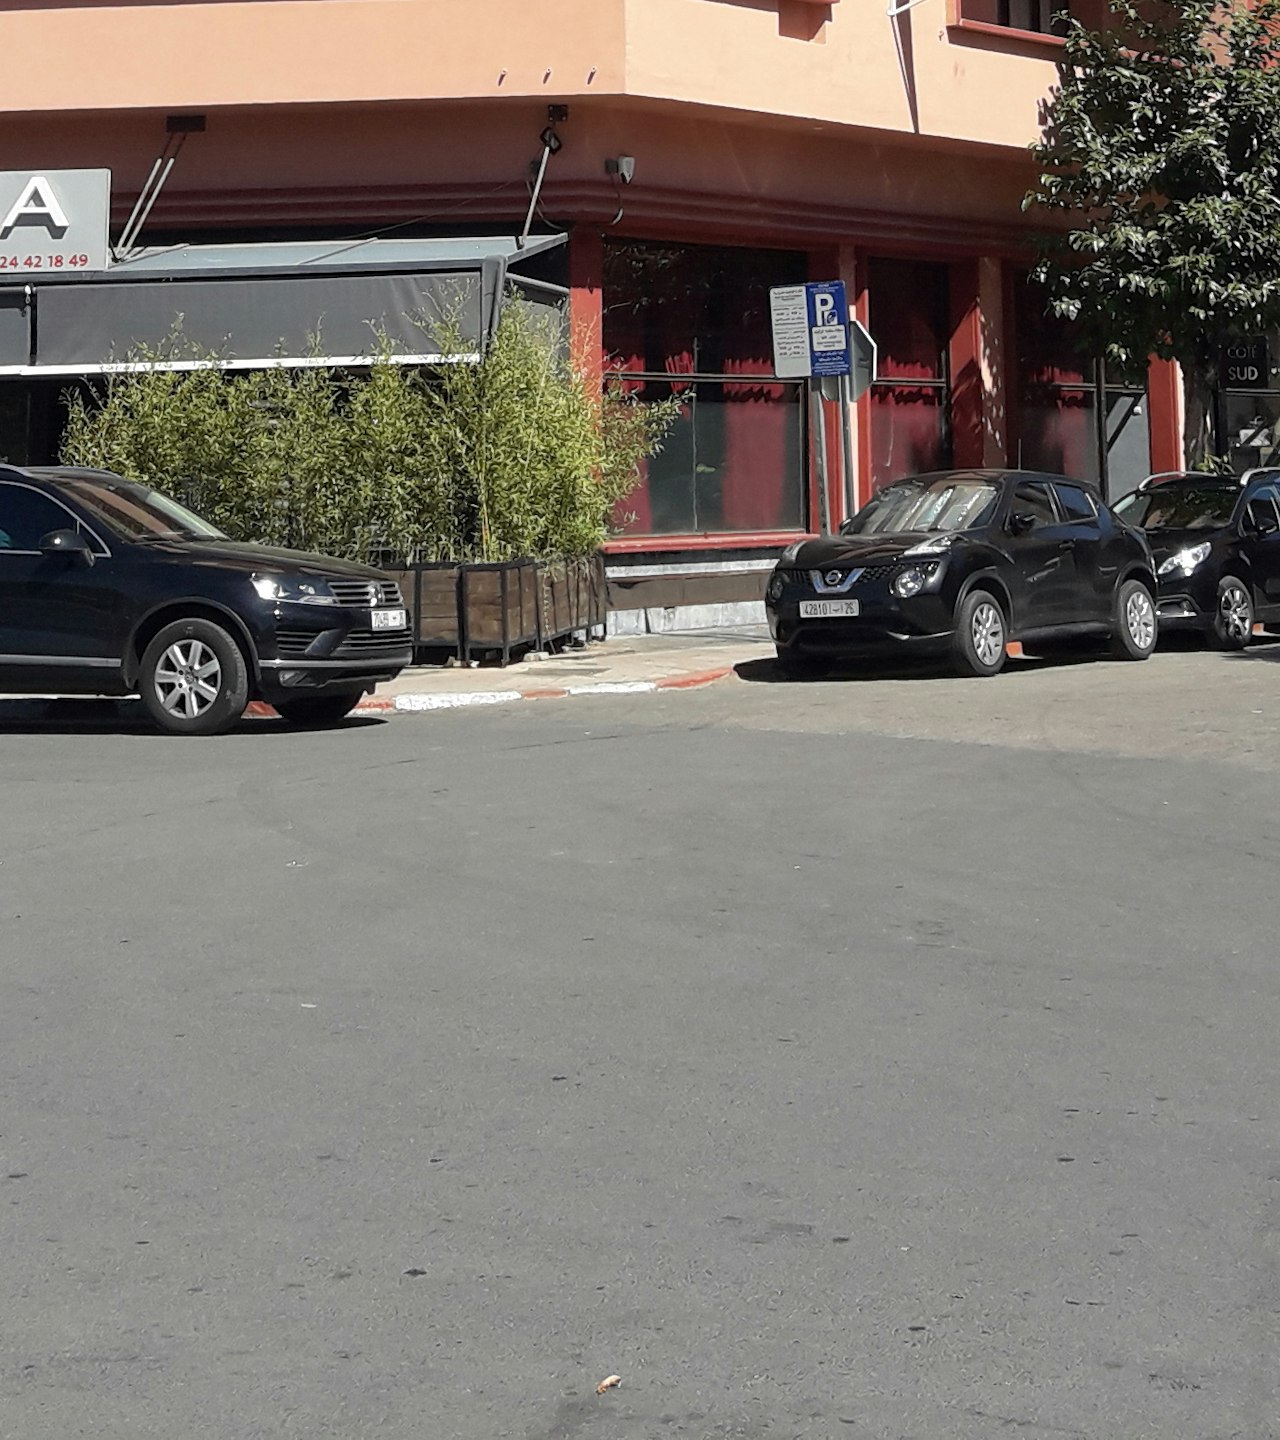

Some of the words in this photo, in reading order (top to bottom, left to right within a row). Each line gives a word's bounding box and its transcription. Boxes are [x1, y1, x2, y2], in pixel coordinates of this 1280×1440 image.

[22, 255, 42, 270] 42
[46, 255, 64, 269] 18
[68, 253, 89, 268] 49
[815, 293, 834, 327] P
[1227, 365, 1259, 381] SUD
